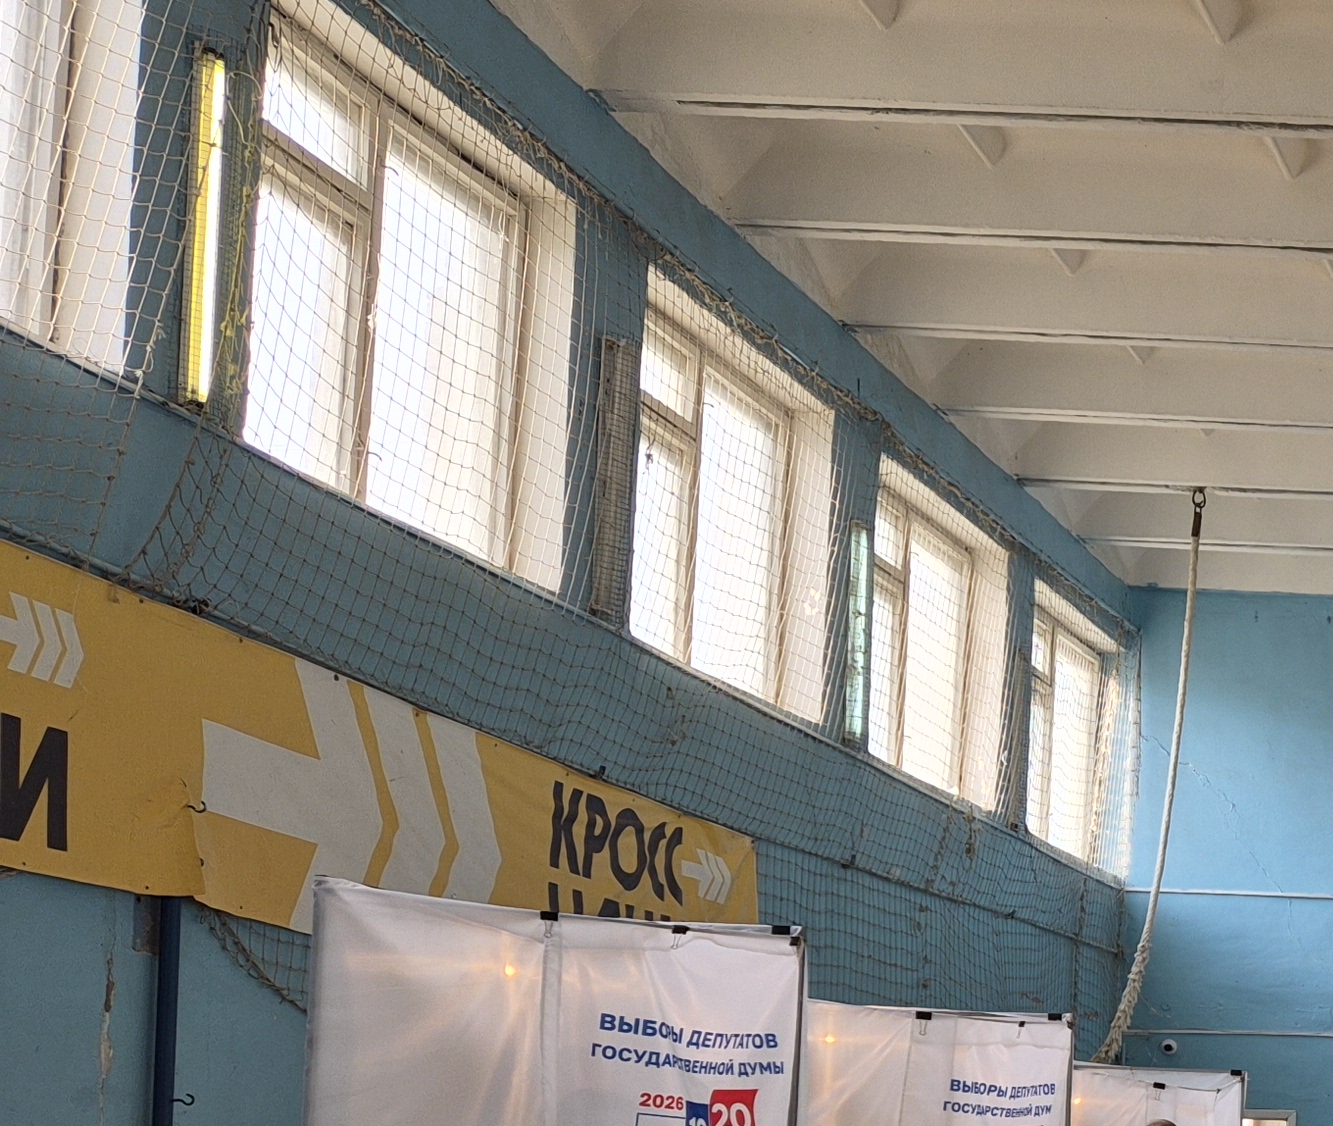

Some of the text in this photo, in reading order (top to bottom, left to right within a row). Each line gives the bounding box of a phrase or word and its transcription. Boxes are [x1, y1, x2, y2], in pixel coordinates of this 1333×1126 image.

[549, 780, 683, 907] КРОСС
[599, 1012, 778, 1050] ВЫБОРЫ ДЕПУТАТОВ
[590, 1042, 784, 1078] ГОСУДАРТВЕННОЙ ДУМЫ
[638, 1092, 684, 1111] 2026
[950, 1078, 1008, 1098] ВЫБОРЫ
[943, 1101, 1052, 1118] ГОСУДАРСТВЕОЙ ДУМ
